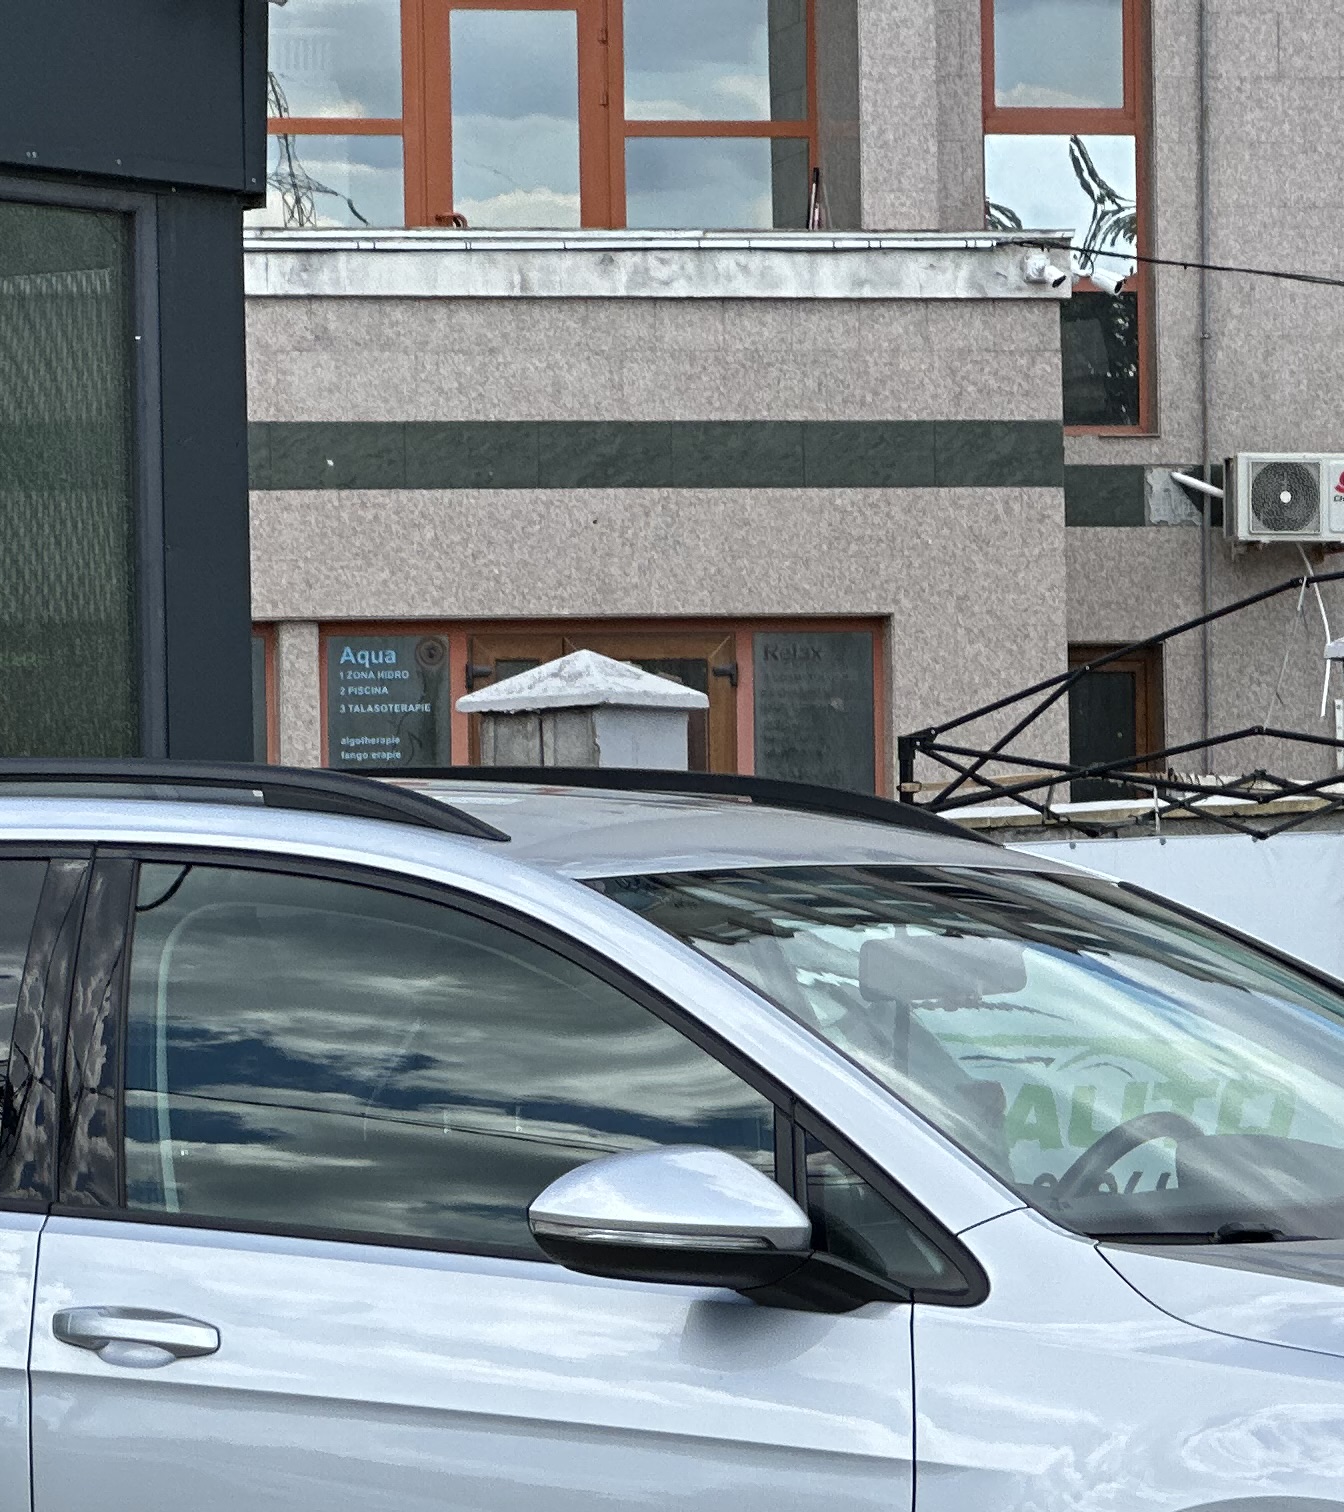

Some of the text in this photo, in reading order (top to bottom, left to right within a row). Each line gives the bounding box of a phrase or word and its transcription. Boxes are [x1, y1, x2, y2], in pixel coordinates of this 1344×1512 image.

[339, 646, 396, 668] Aqua
[346, 670, 375, 679] ZONA
[377, 670, 409, 679] HIDRO
[348, 686, 389, 695] PISCINA
[340, 703, 431, 713] 3 TALASOTERAPIE
